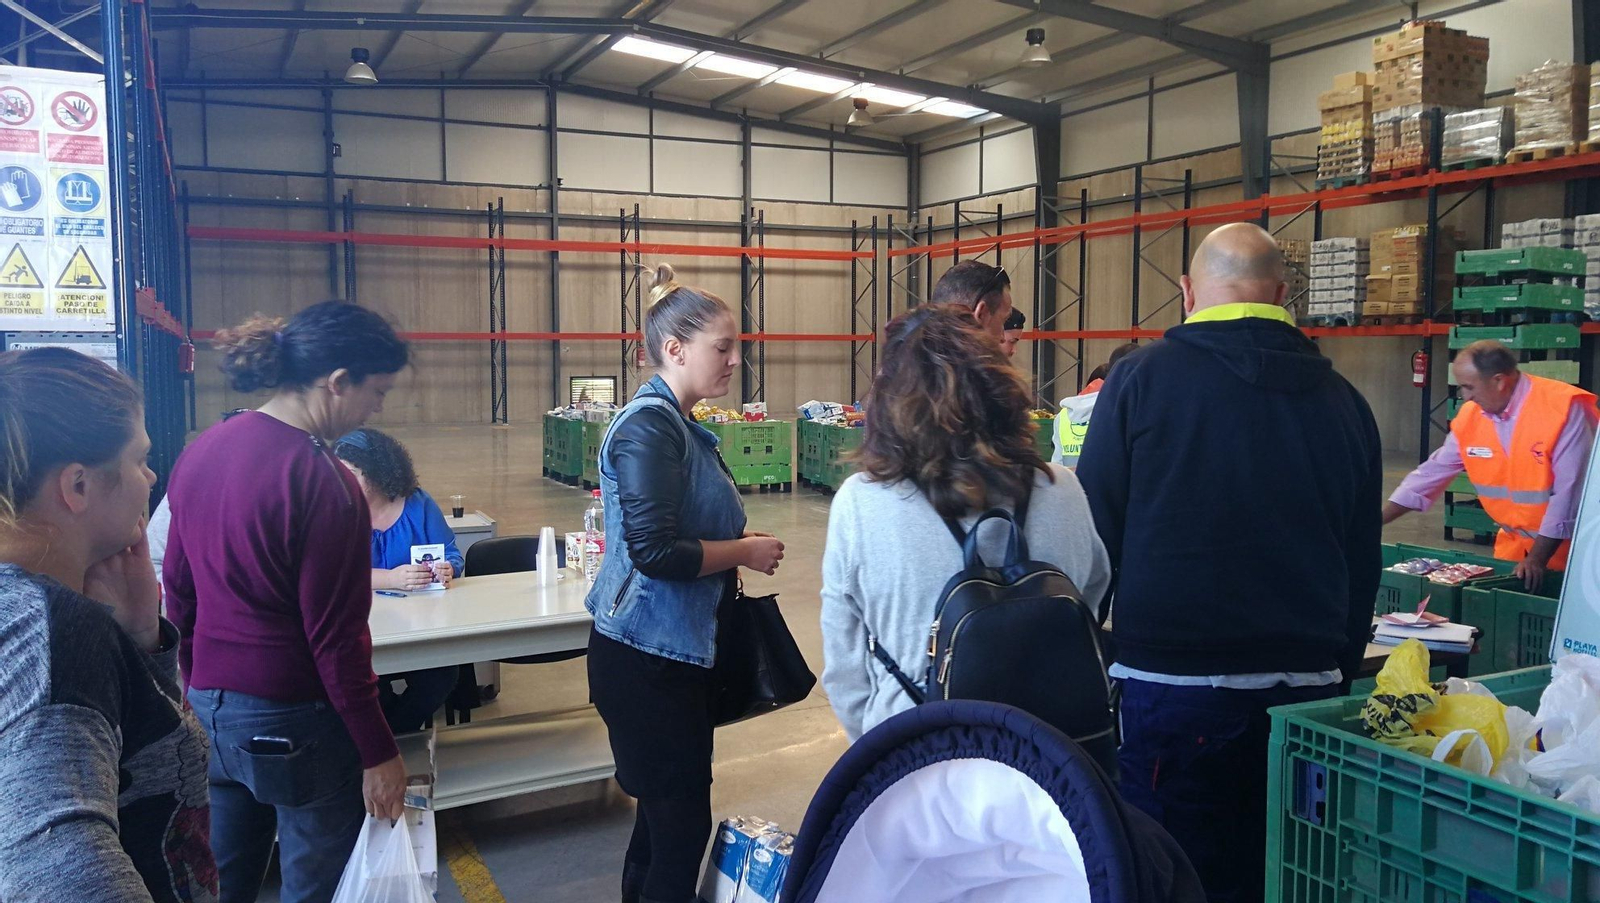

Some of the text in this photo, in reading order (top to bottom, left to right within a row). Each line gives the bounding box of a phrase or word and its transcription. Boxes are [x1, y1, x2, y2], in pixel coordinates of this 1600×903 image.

[3, 218, 44, 227] OBLIGATORIO
[7, 226, 36, 234] GUANTES
[3, 292, 31, 300] PELIGRO
[1574, 640, 1597, 652] PLAYA
